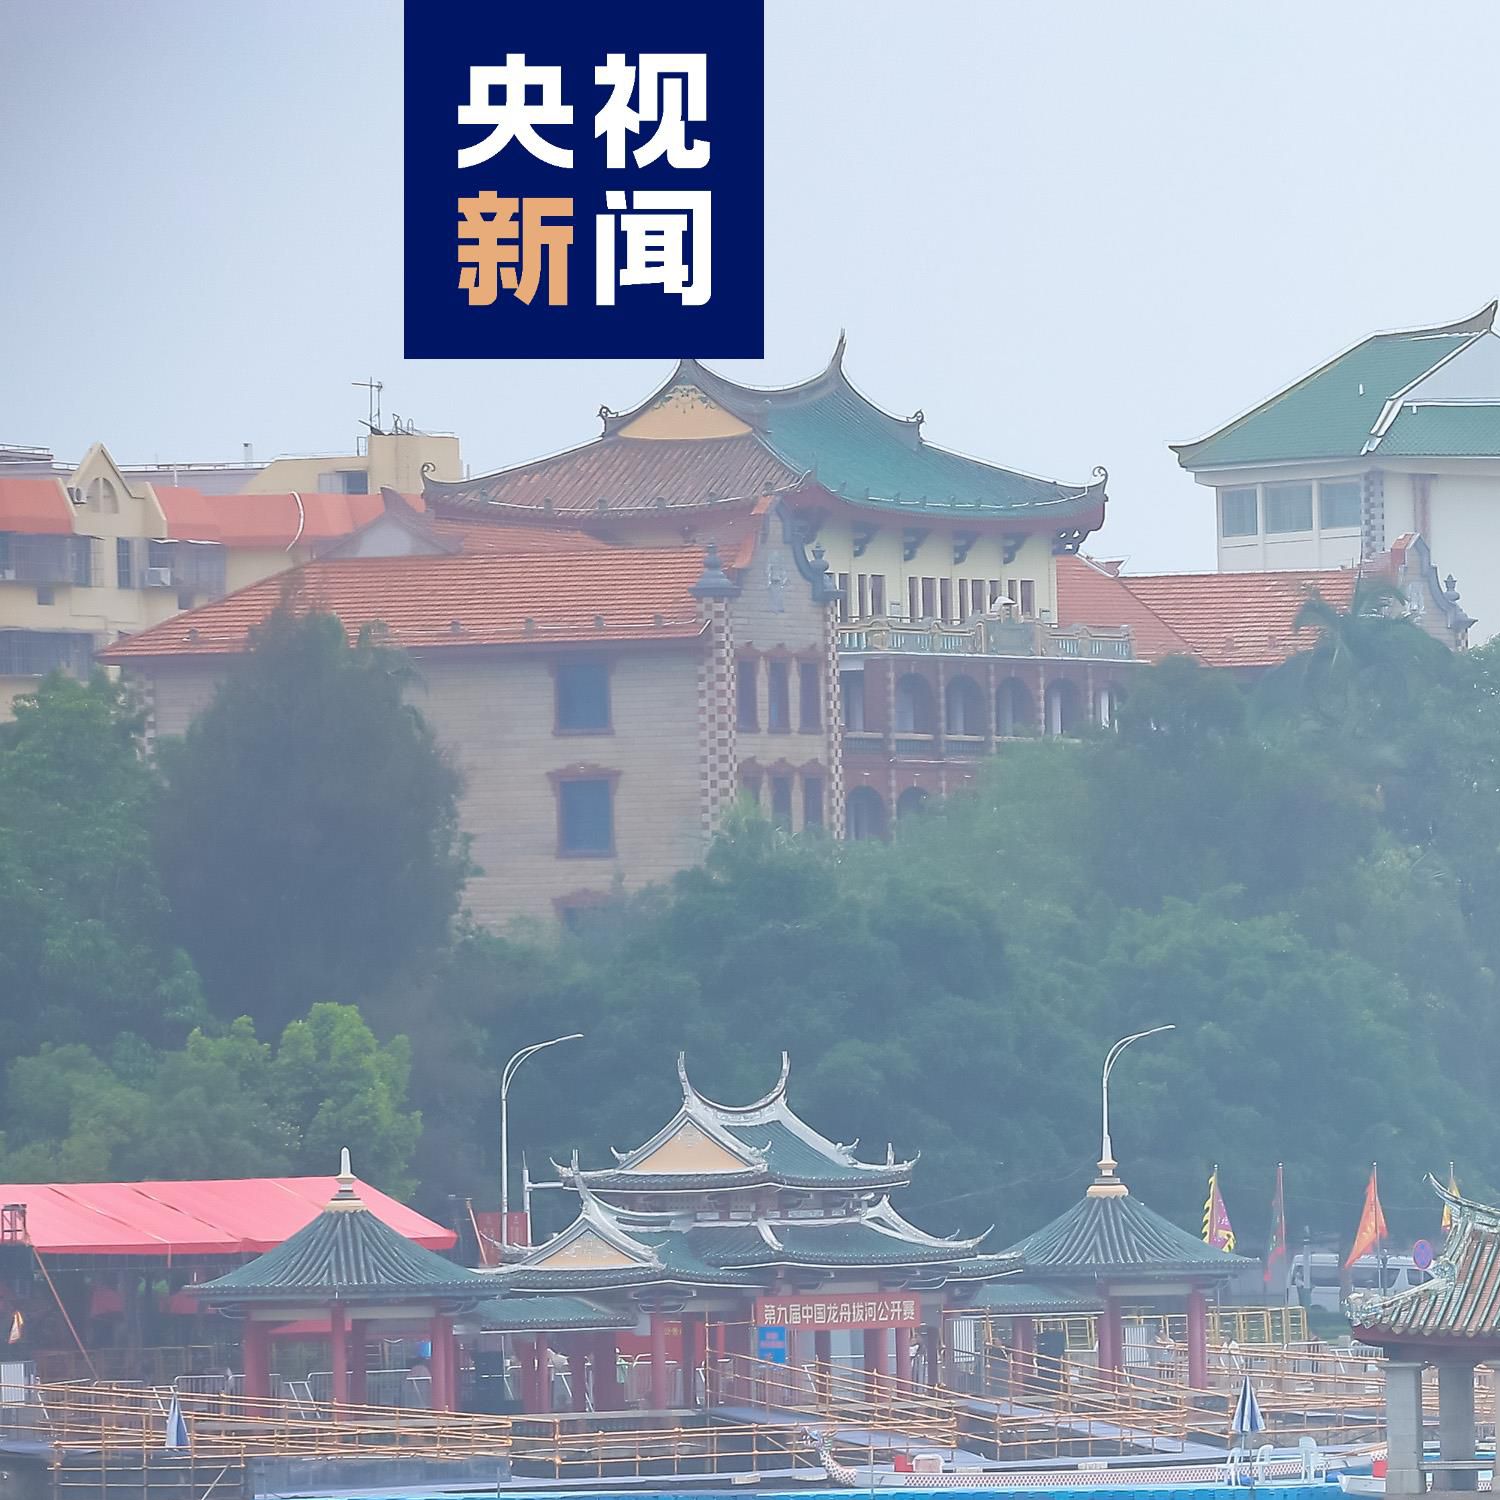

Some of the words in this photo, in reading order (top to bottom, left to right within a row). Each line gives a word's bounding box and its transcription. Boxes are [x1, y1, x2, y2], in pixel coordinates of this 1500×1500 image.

[764, 1300, 915, 1325] 第九届中国龙舟拔河公开赛
